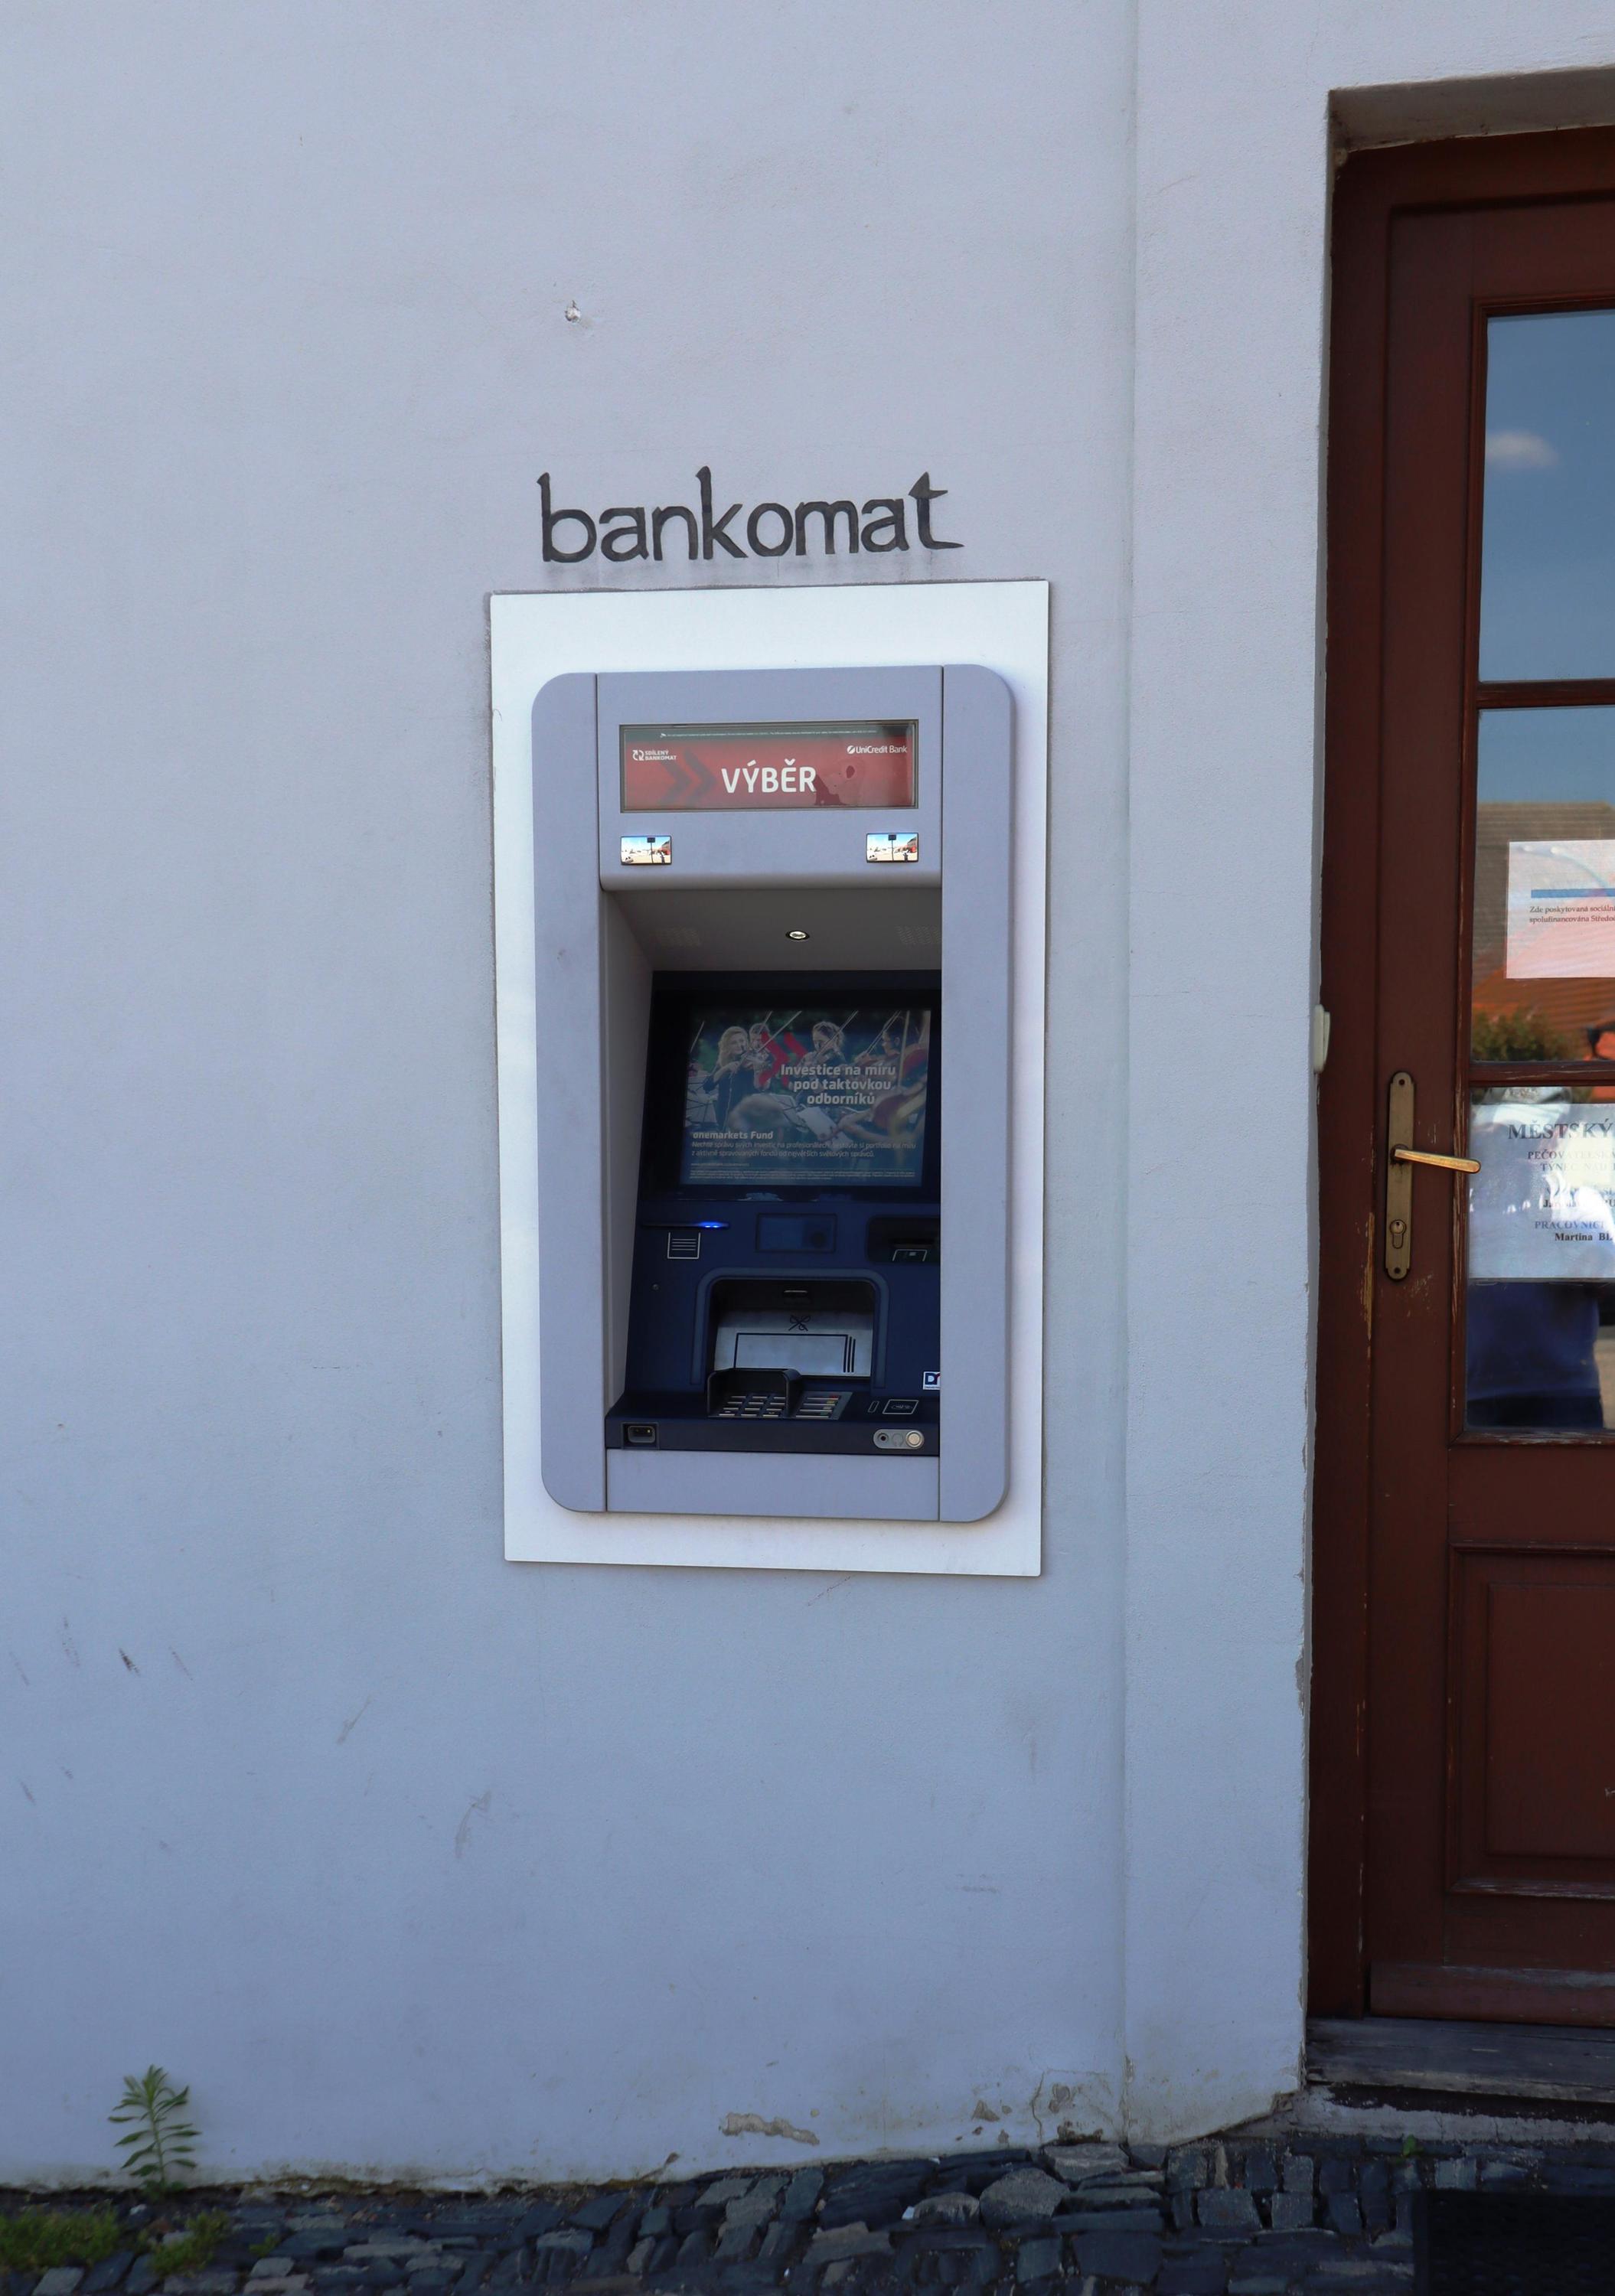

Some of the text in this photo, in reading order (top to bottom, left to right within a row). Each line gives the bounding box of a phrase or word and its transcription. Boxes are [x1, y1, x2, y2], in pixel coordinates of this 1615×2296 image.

[537, 465, 964, 563] bankomat
[856, 745, 908, 755] UniCredit Bank
[721, 758, 817, 793] VÝBĚR
[781, 1064, 896, 1075] Investice na míru
[794, 1078, 891, 1091] pod taktovkou
[808, 1093, 875, 1104] odborníků
[1508, 1119, 1612, 1140] MĚSTSKÝ
[693, 1131, 773, 1140] onemarkets Fund
[1555, 1232, 1593, 1241] Martina
